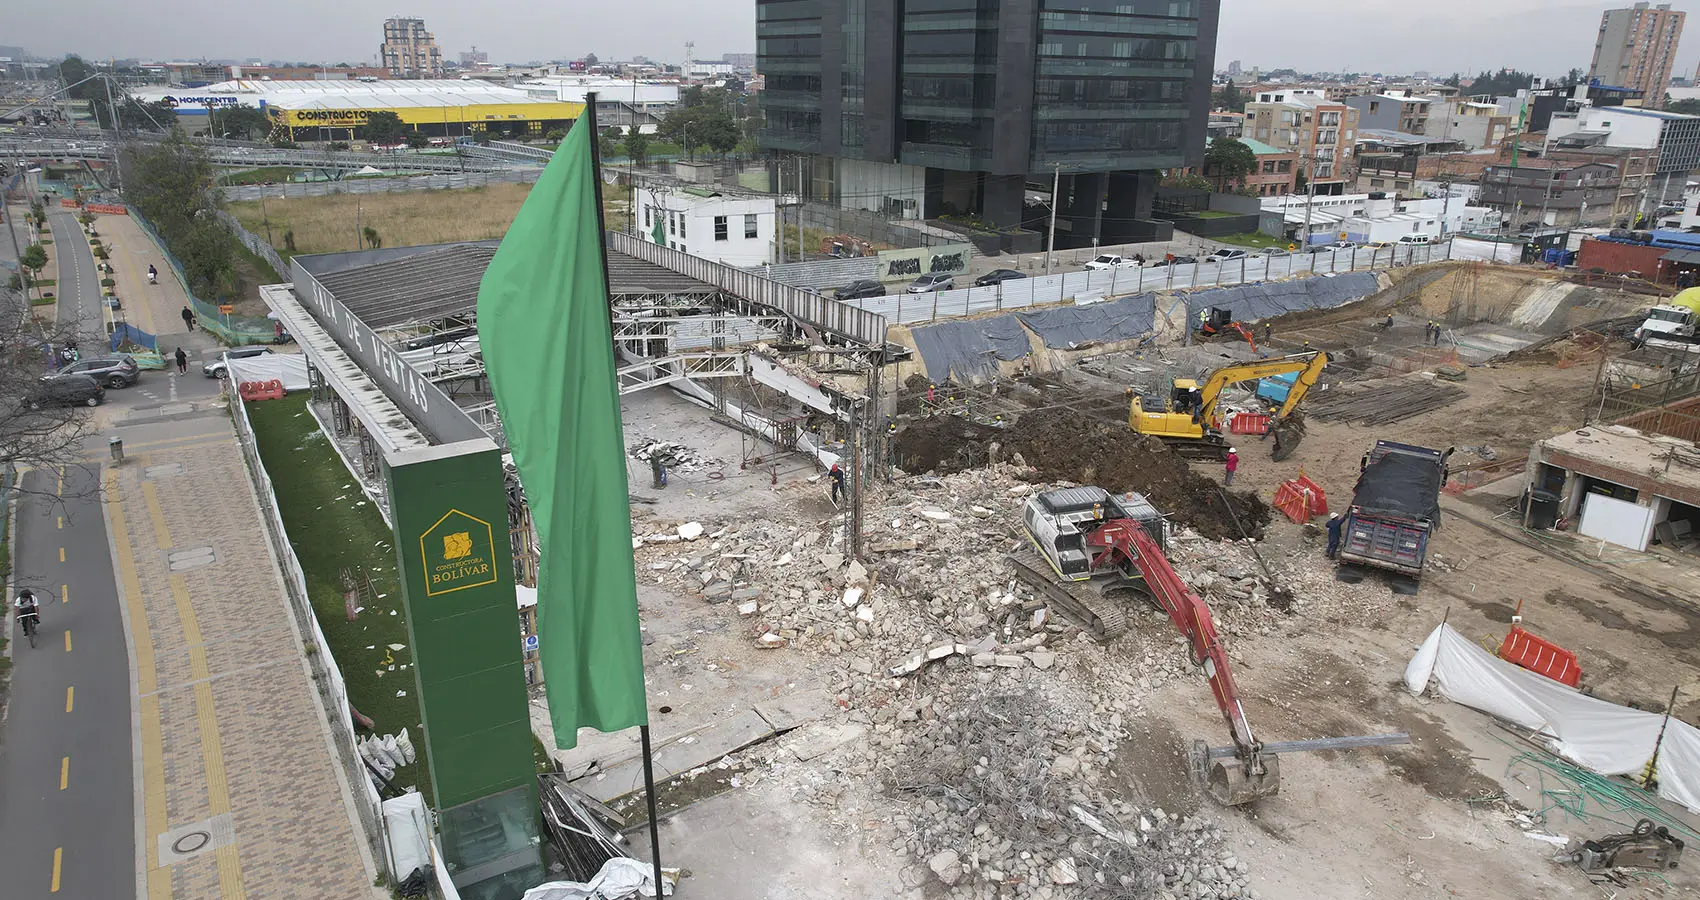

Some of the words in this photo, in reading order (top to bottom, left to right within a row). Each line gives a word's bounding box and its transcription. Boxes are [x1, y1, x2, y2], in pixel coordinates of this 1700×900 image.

[179, 96, 238, 104] HOMECENTER
[312, 281, 337, 324] SALA
[345, 311, 363, 352] DE
[371, 335, 428, 413] VENTAS
[436, 557, 484, 571] CONSTRUCTORA
[433, 564, 488, 583] BOLÍVAR
